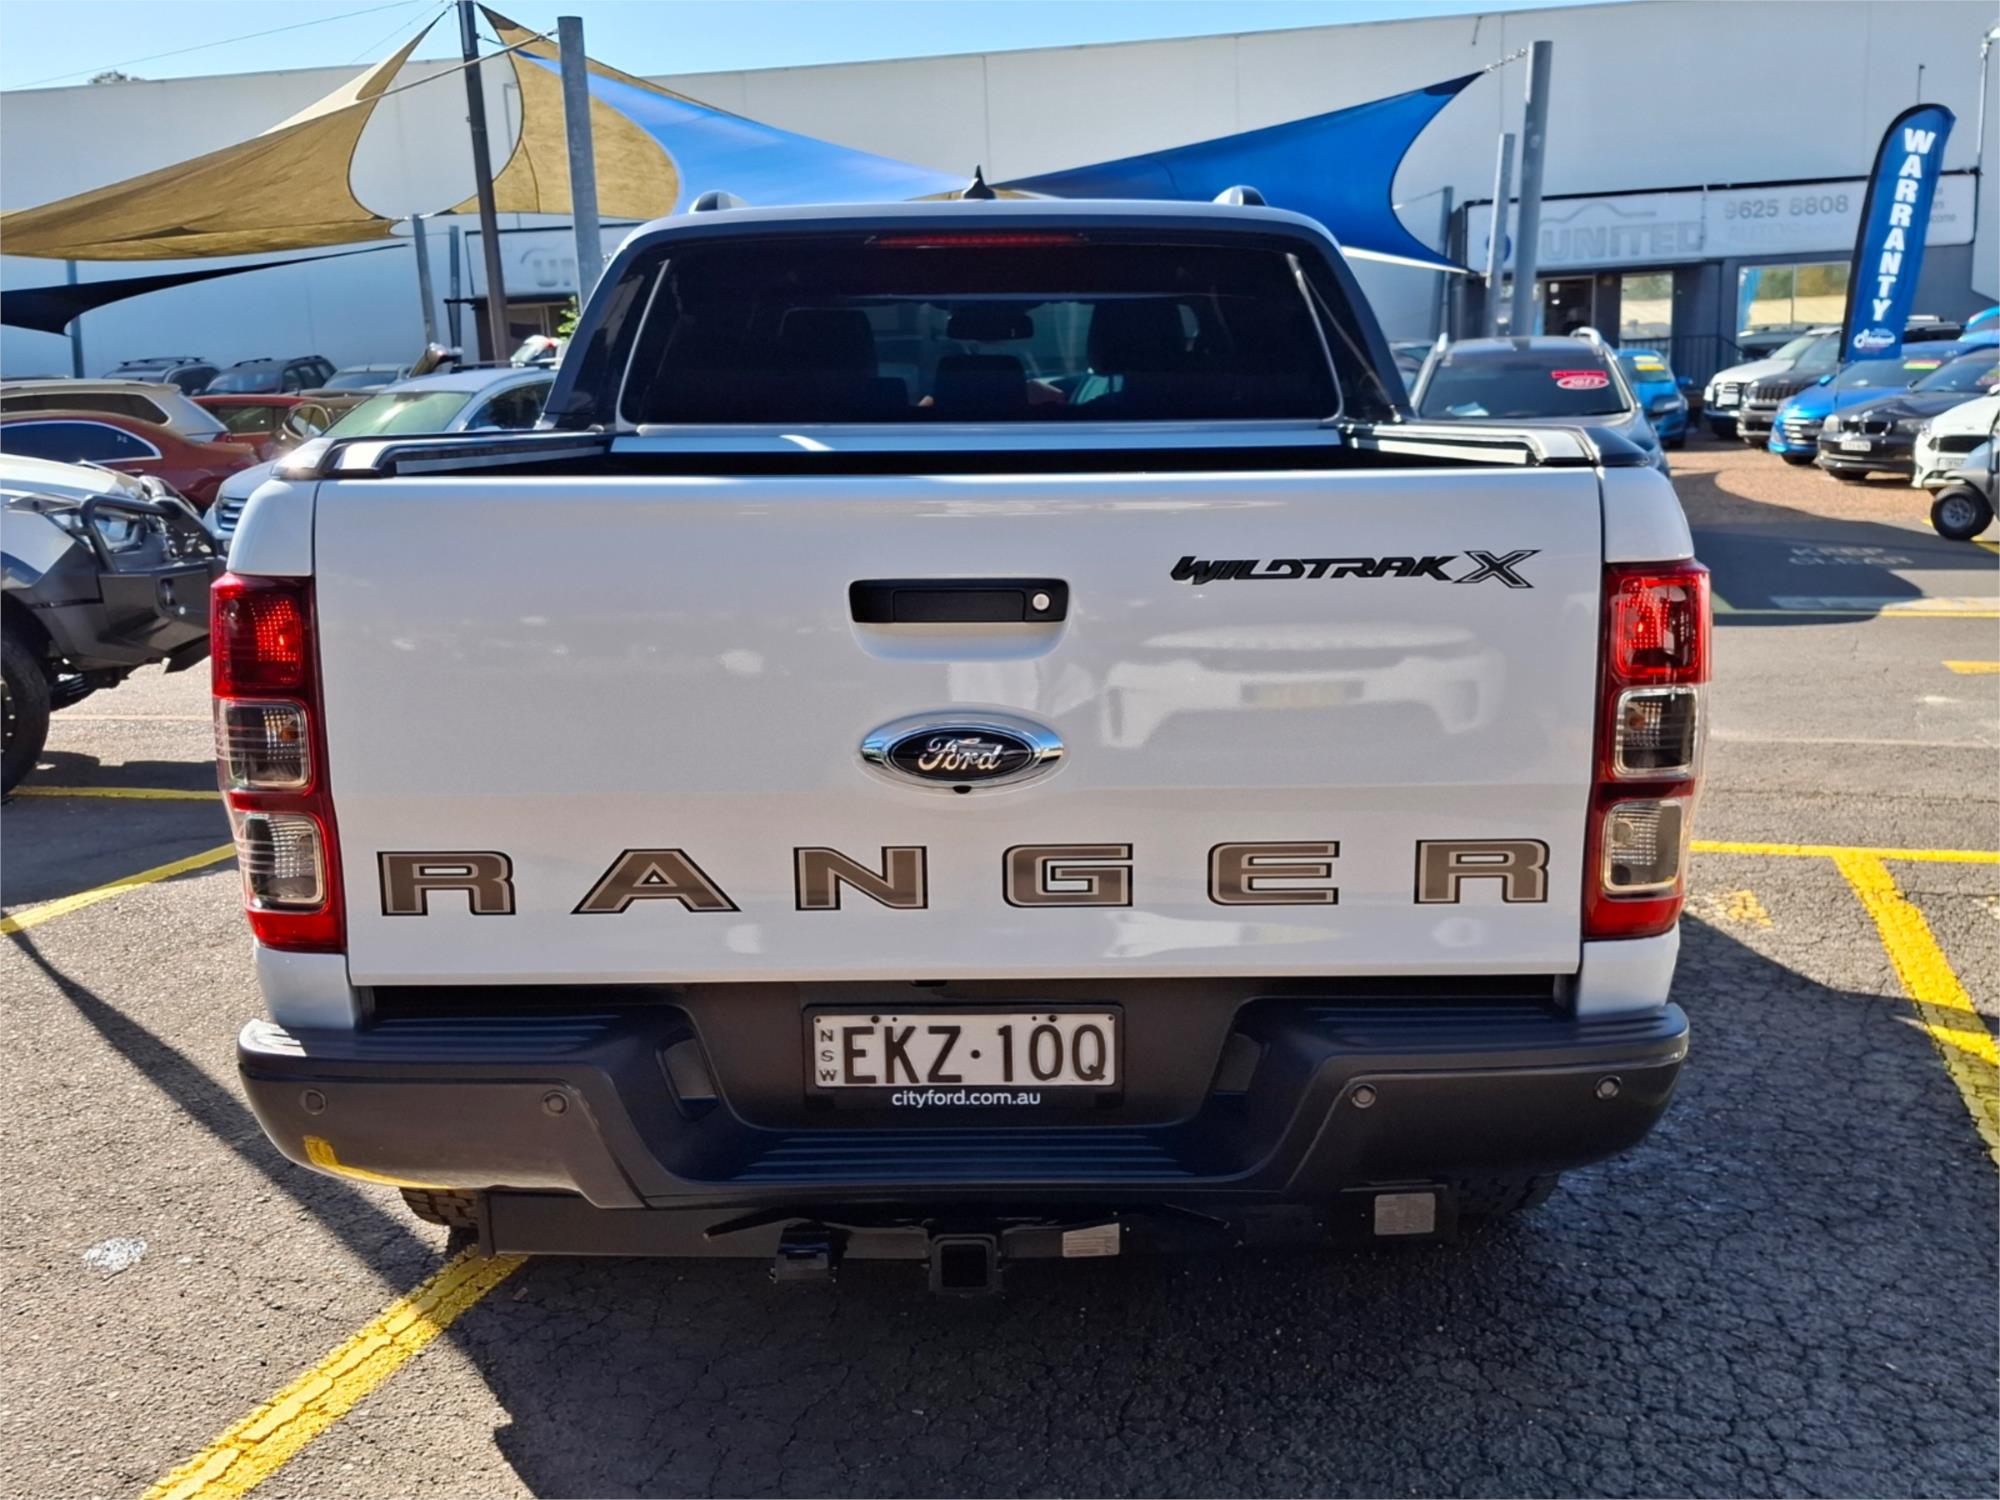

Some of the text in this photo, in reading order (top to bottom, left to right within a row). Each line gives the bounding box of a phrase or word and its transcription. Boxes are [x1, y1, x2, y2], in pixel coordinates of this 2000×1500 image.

[1724, 194, 1850, 219] 9625 8808
[1872, 128, 1936, 321] WARRANTY
[1541, 221, 1707, 261] UNITED
[918, 735, 1003, 771] Ford
[376, 838, 1550, 916] RANGER
[891, 1089, 1041, 1109] cityford.com.au
